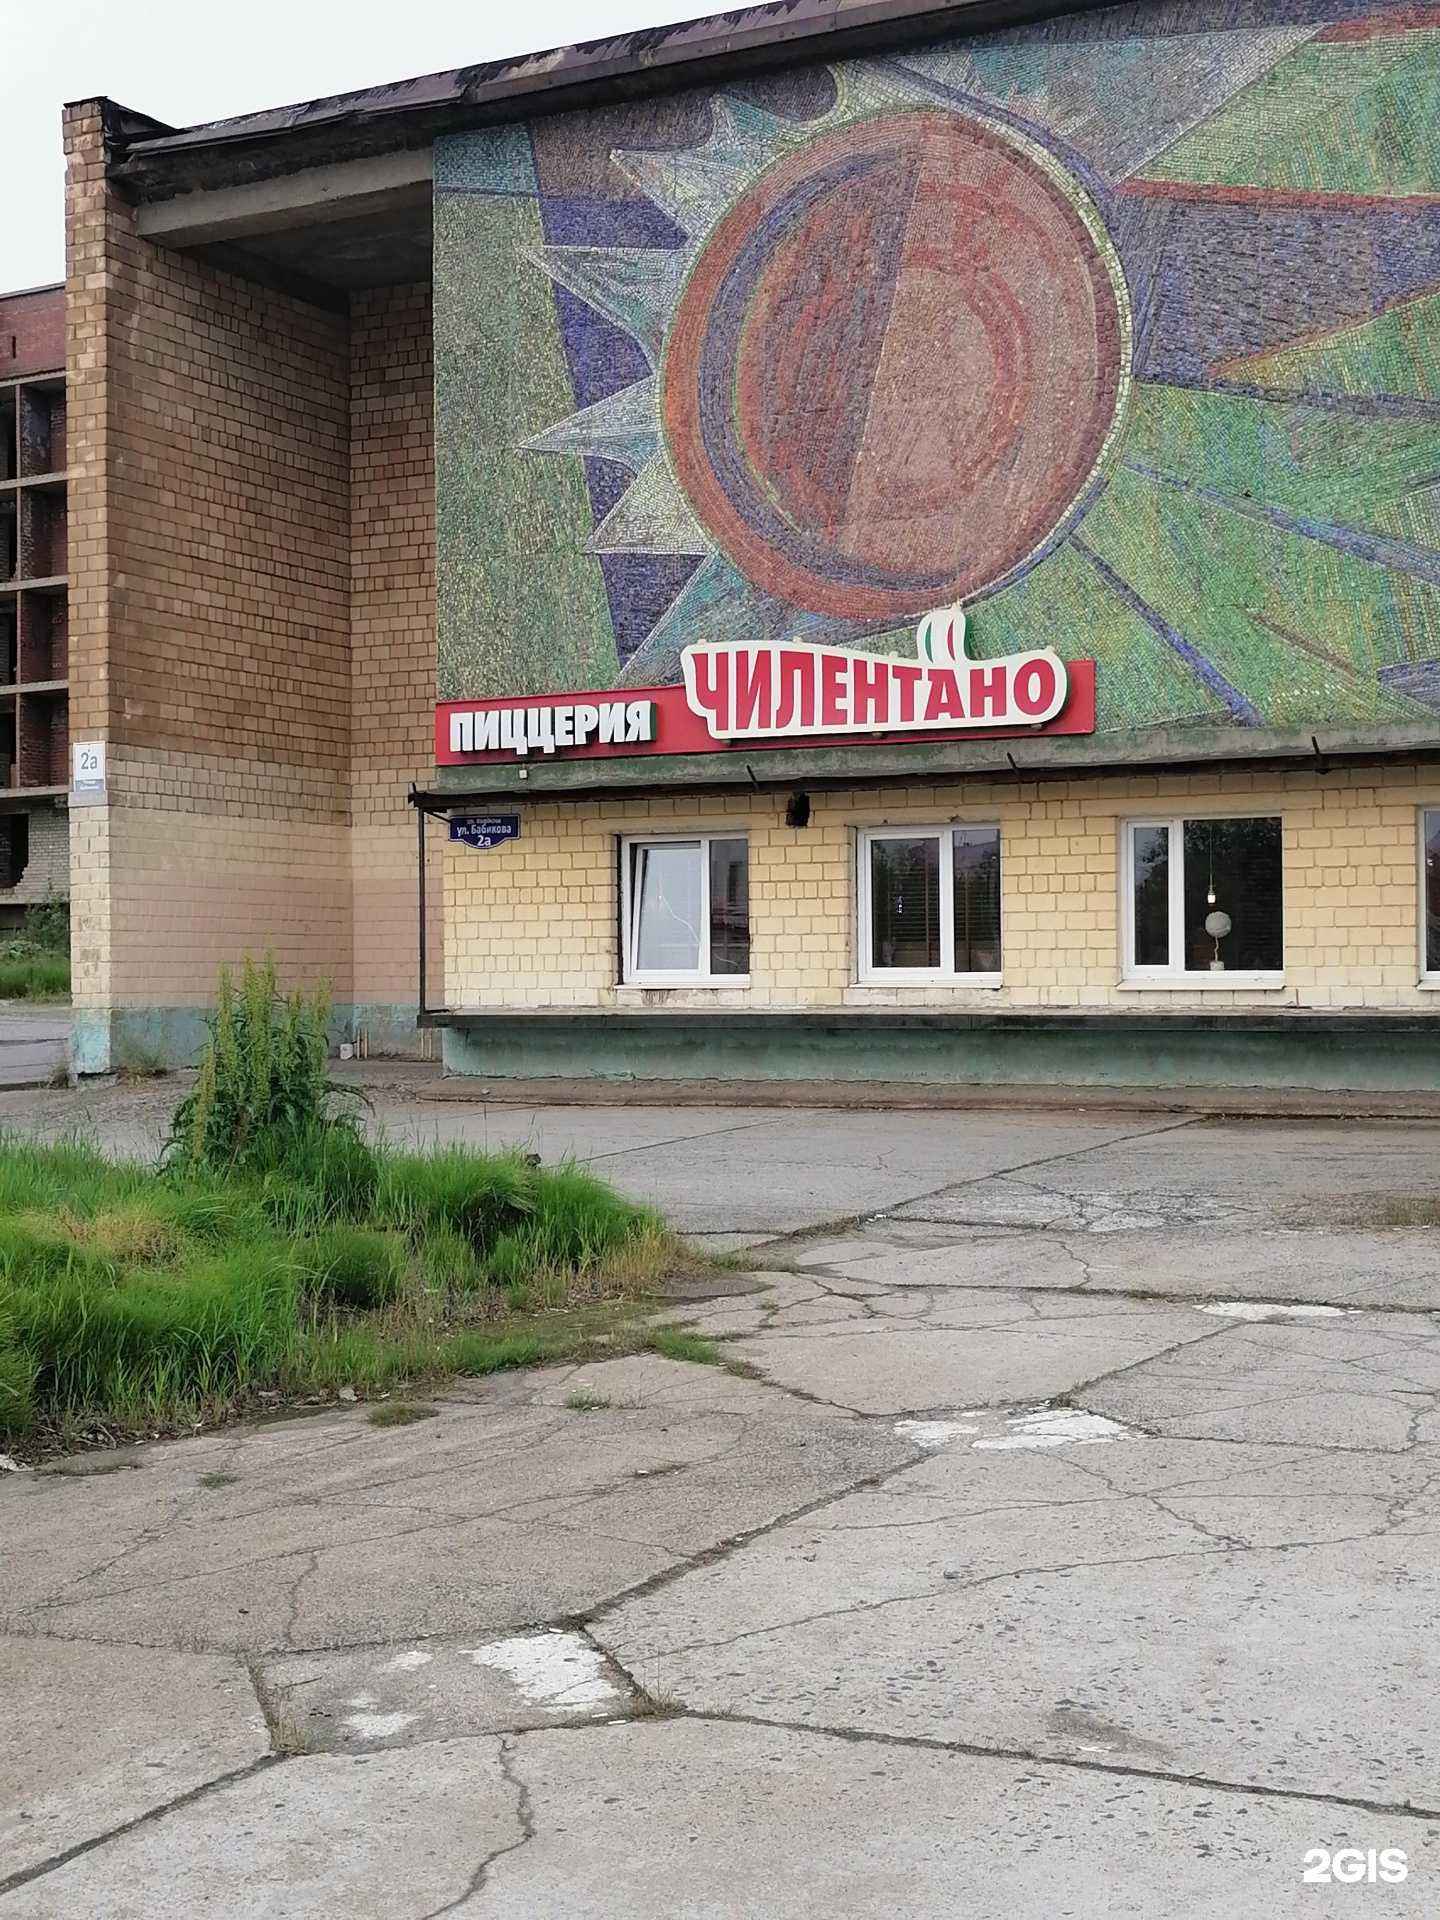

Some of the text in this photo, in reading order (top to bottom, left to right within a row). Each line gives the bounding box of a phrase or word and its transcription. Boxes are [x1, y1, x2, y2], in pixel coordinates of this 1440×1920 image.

[692, 650, 1056, 732] ЧИЛЕНТАНО
[449, 701, 652, 755] ПИЦЦЕРИЯ
[81, 752, 98, 770] 2а
[457, 823, 512, 837] ул. Бабикова
[477, 835, 491, 847] 2а
